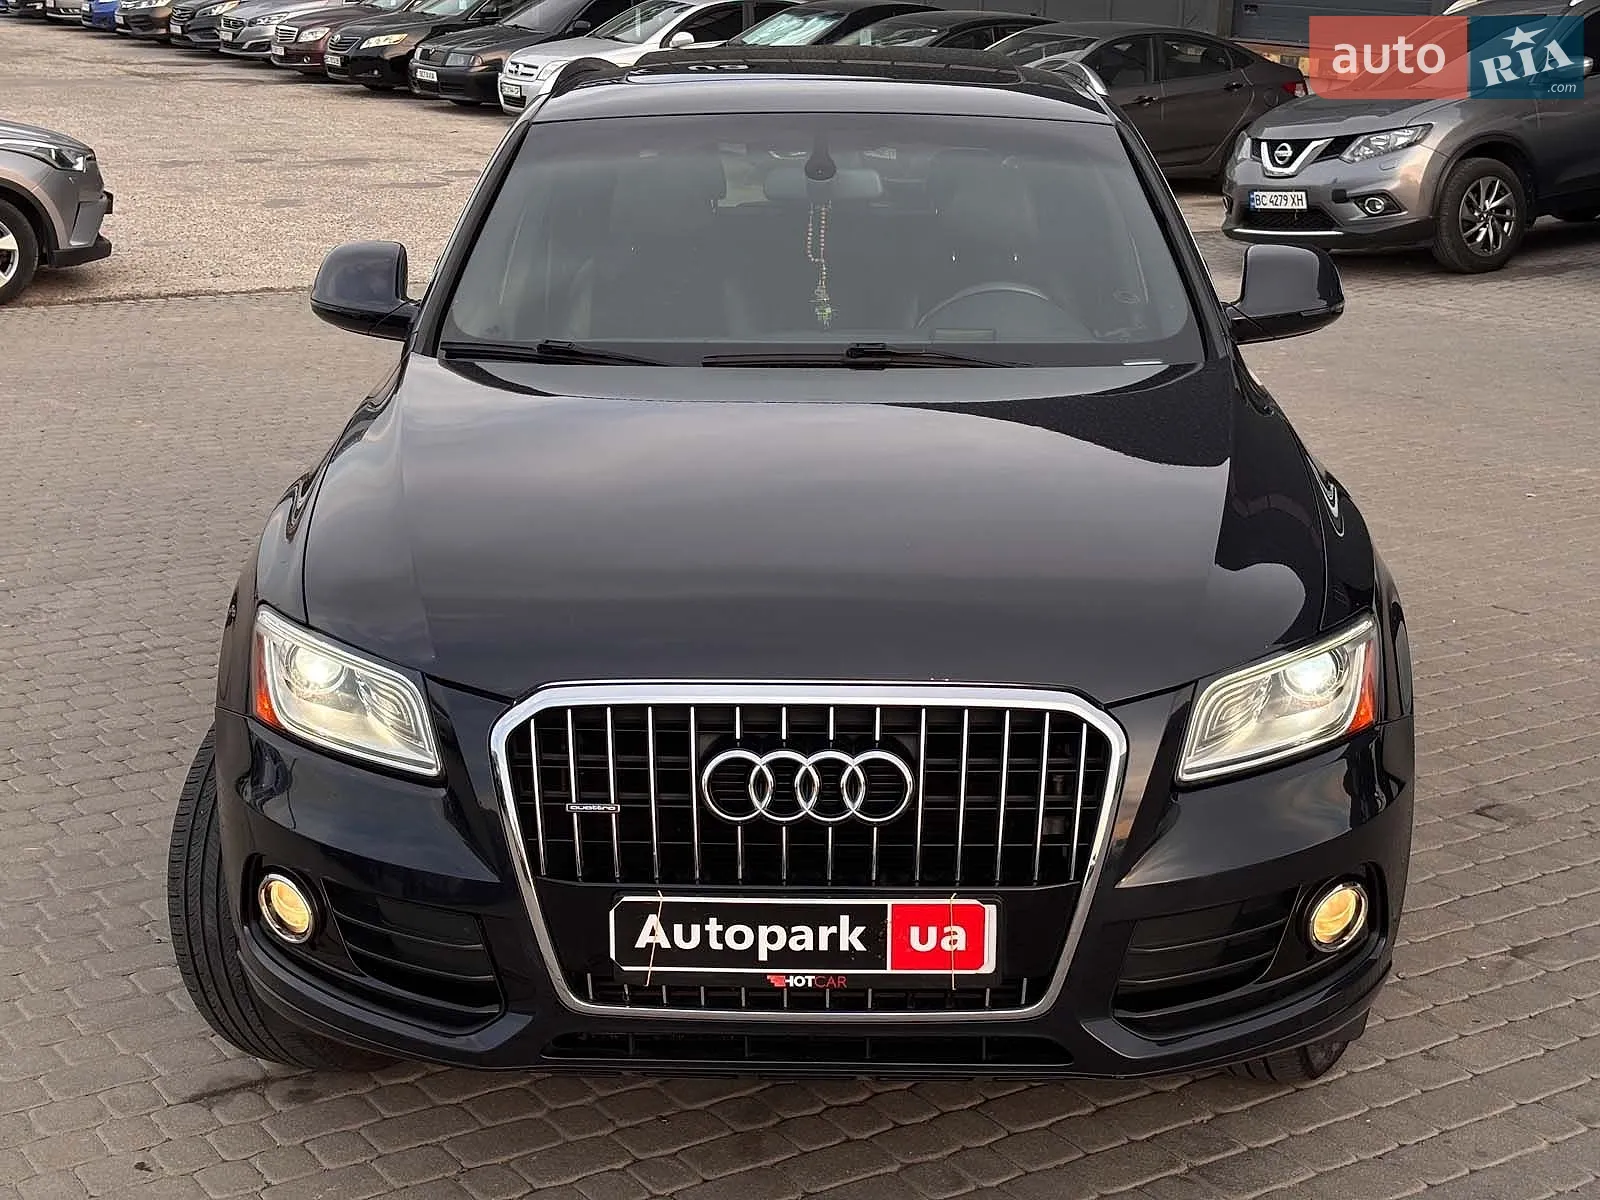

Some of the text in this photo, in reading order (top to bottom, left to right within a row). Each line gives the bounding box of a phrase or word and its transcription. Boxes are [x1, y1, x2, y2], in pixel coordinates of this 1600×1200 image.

[1255, 194, 1304, 207] BC 4279 XH
[634, 914, 967, 961] Autopark ua
